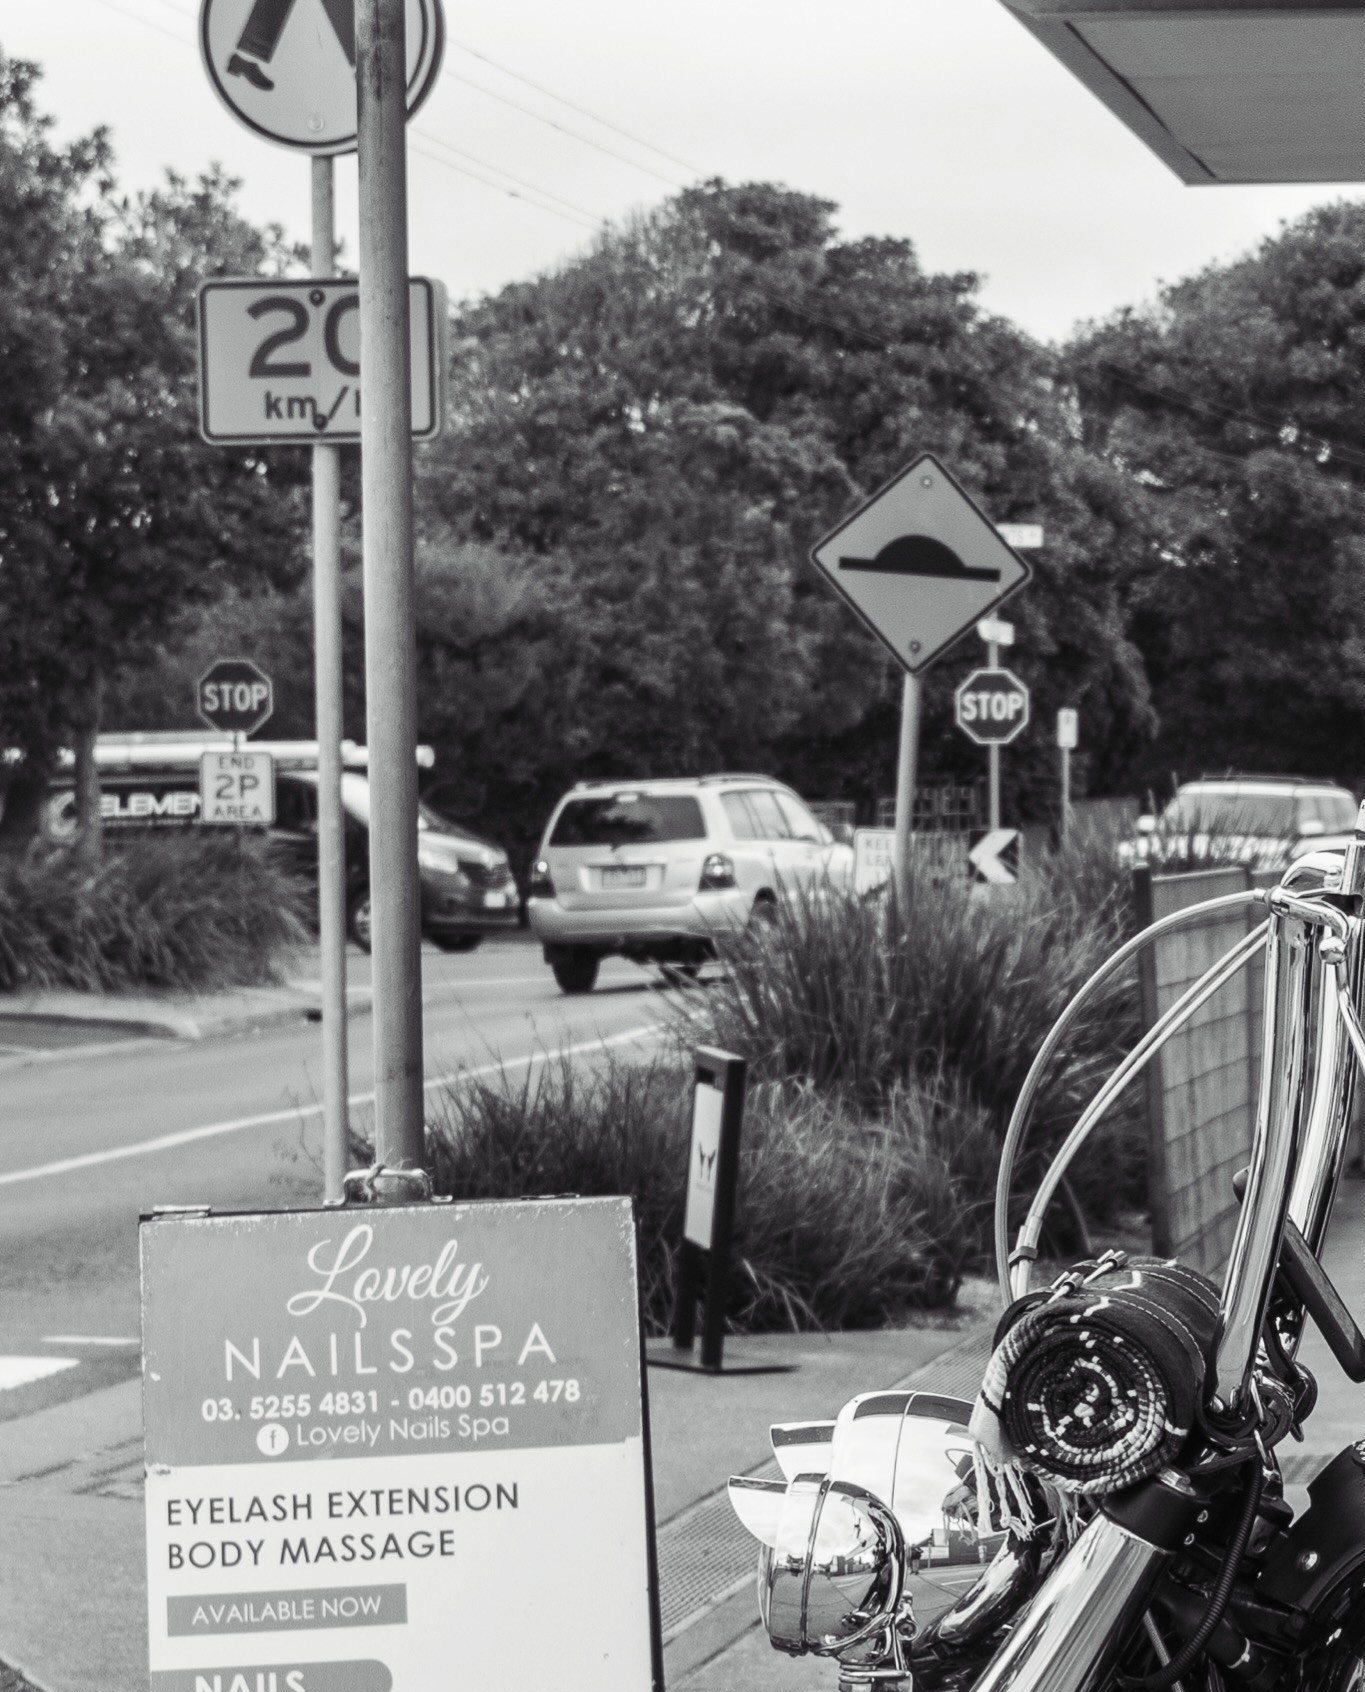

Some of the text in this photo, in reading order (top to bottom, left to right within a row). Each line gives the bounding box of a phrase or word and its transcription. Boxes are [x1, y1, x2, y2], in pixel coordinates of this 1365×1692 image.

[203, 682, 268, 712] STOP
[961, 691, 1023, 720] STOP
[218, 755, 254, 770] END
[216, 774, 259, 799] 2P
[213, 804, 263, 820] AREA
[287, 1225, 489, 1327] Lovely
[202, 1398, 241, 1422] 03.
[249, 1394, 311, 1418] 5255
[319, 1391, 378, 1415] 4831
[408, 1386, 471, 1410] 0400
[479, 1383, 525, 1407] 512
[533, 1380, 581, 1404] 478
[297, 1421, 380, 1447] Lovely
[390, 1416, 451, 1441] Nails
[458, 1414, 509, 1441] Spa
[166, 1482, 519, 1526] EYELASH EXTENSION
[168, 1529, 456, 1570] BODY MASSAGE
[192, 1595, 382, 1626] AVAILABLE NOW
